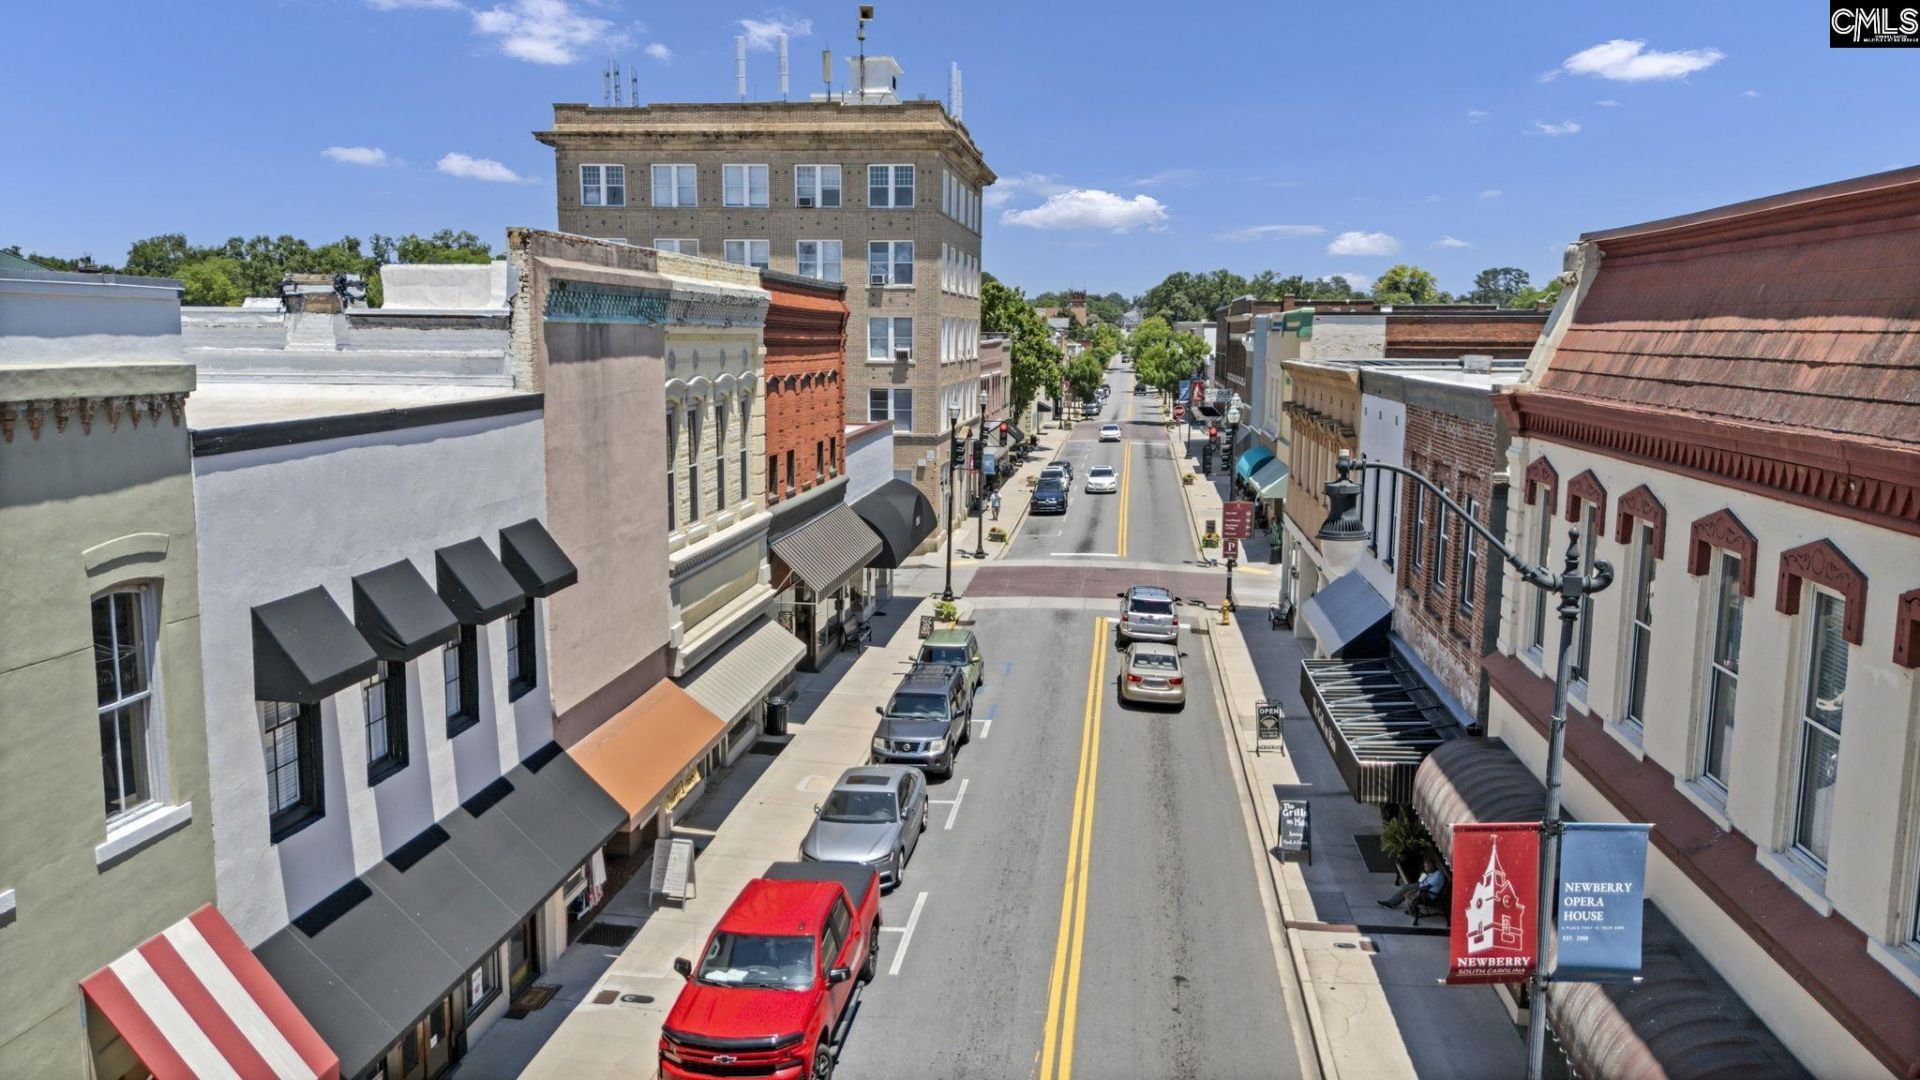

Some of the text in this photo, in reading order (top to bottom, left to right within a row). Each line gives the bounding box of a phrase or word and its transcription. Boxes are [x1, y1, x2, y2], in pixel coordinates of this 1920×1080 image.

[1228, 542, 1236, 551] P
[1564, 882, 1632, 893] NEWBERRY
[1564, 896, 1604, 907] OPERA
[1563, 911, 1604, 921] HOUSE
[1457, 957, 1531, 967] NEWBERRY
